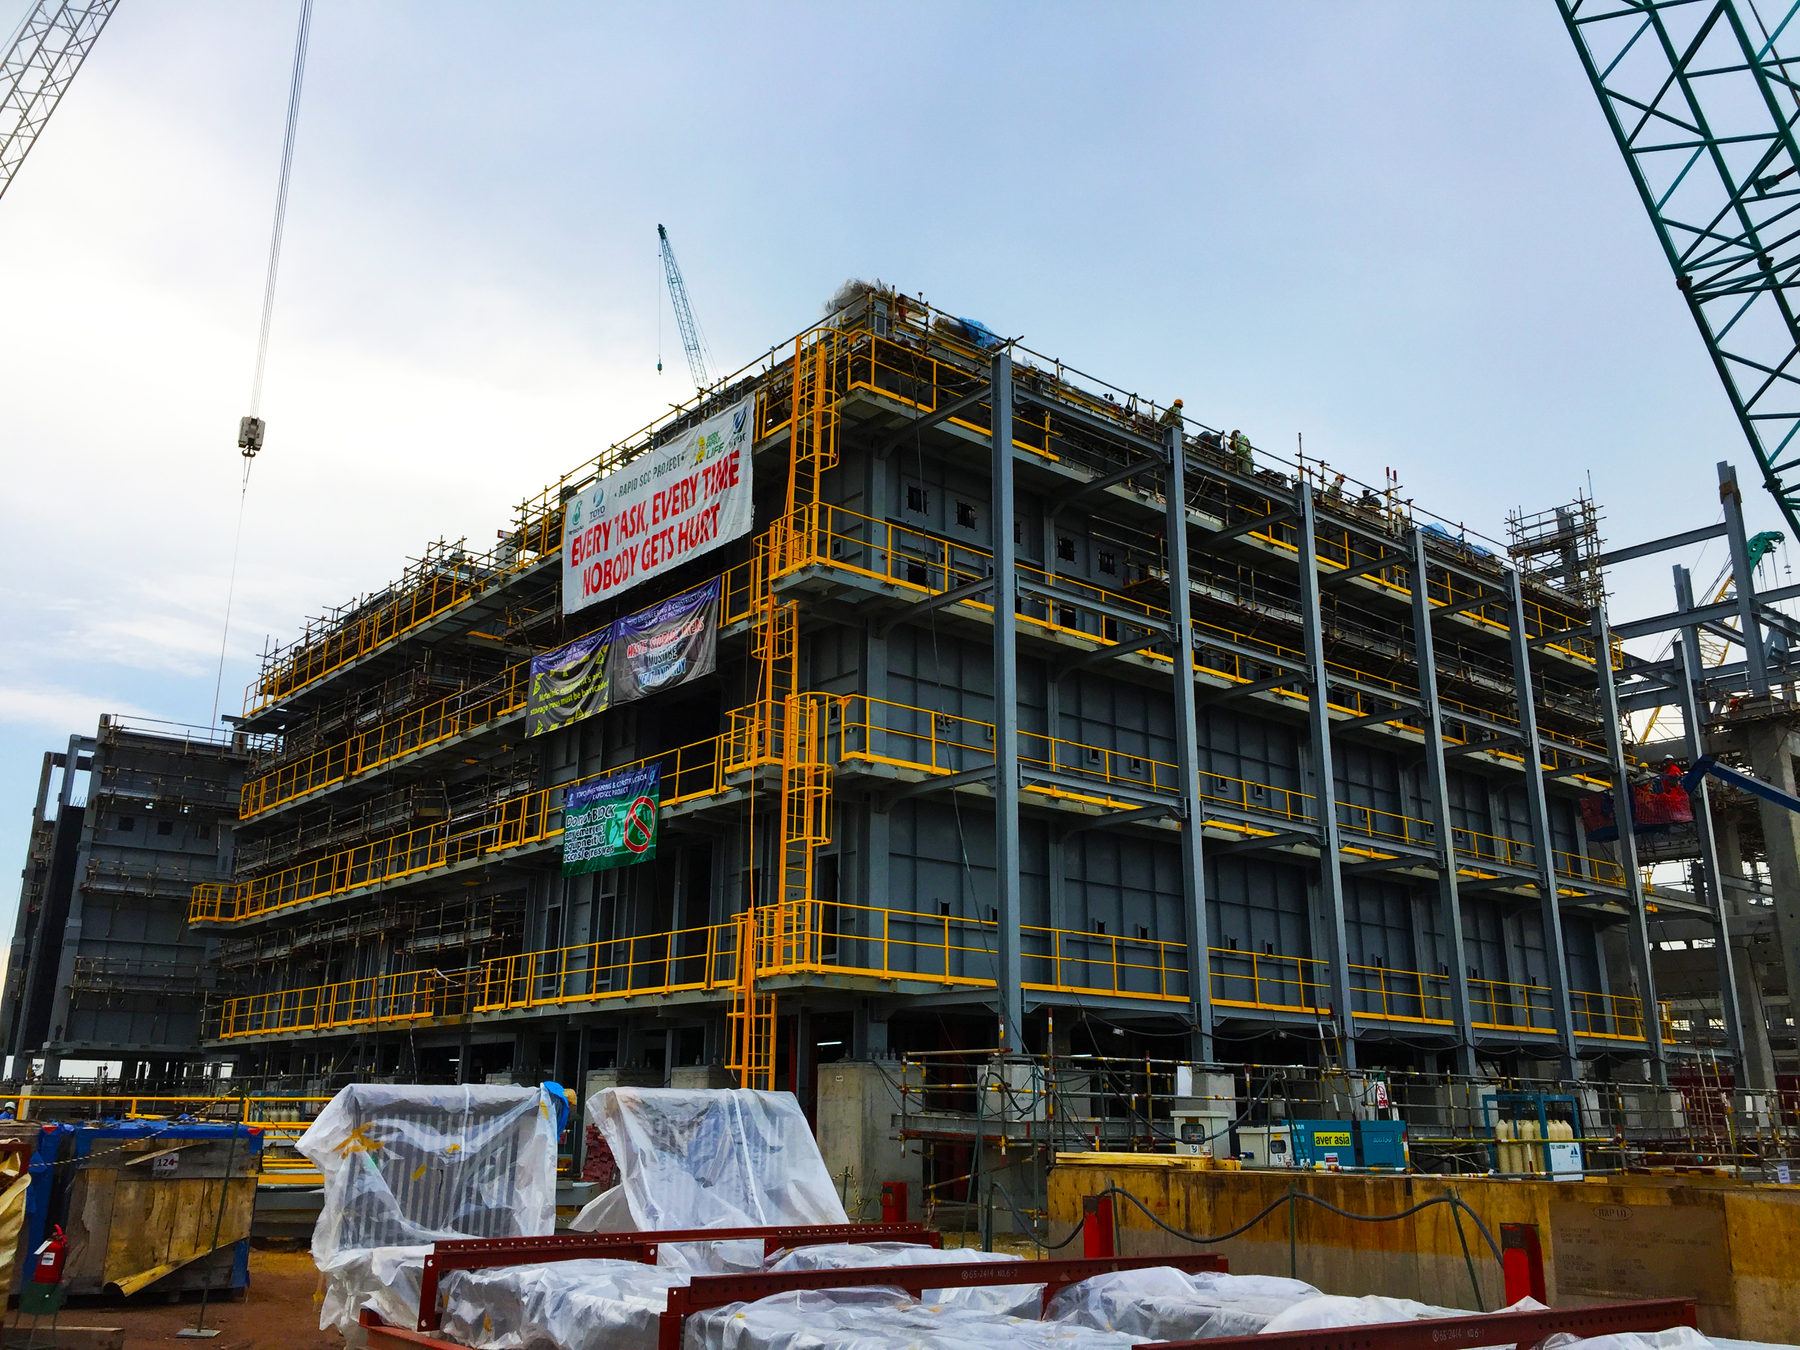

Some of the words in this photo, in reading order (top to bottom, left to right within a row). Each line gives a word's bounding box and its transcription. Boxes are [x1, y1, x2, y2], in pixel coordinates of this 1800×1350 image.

[639, 470, 652, 488] SCC
[652, 453, 681, 480] PROJECT
[571, 518, 613, 568] EVERY
[652, 470, 700, 526] EVERY
[702, 449, 740, 500] TIME
[582, 543, 639, 600] NOBODY
[641, 527, 675, 572] GETS
[677, 502, 721, 555] HURT
[566, 815, 578, 829] Do
[1315, 1135, 1333, 1145] aver
[1334, 1133, 1350, 1145] asia
